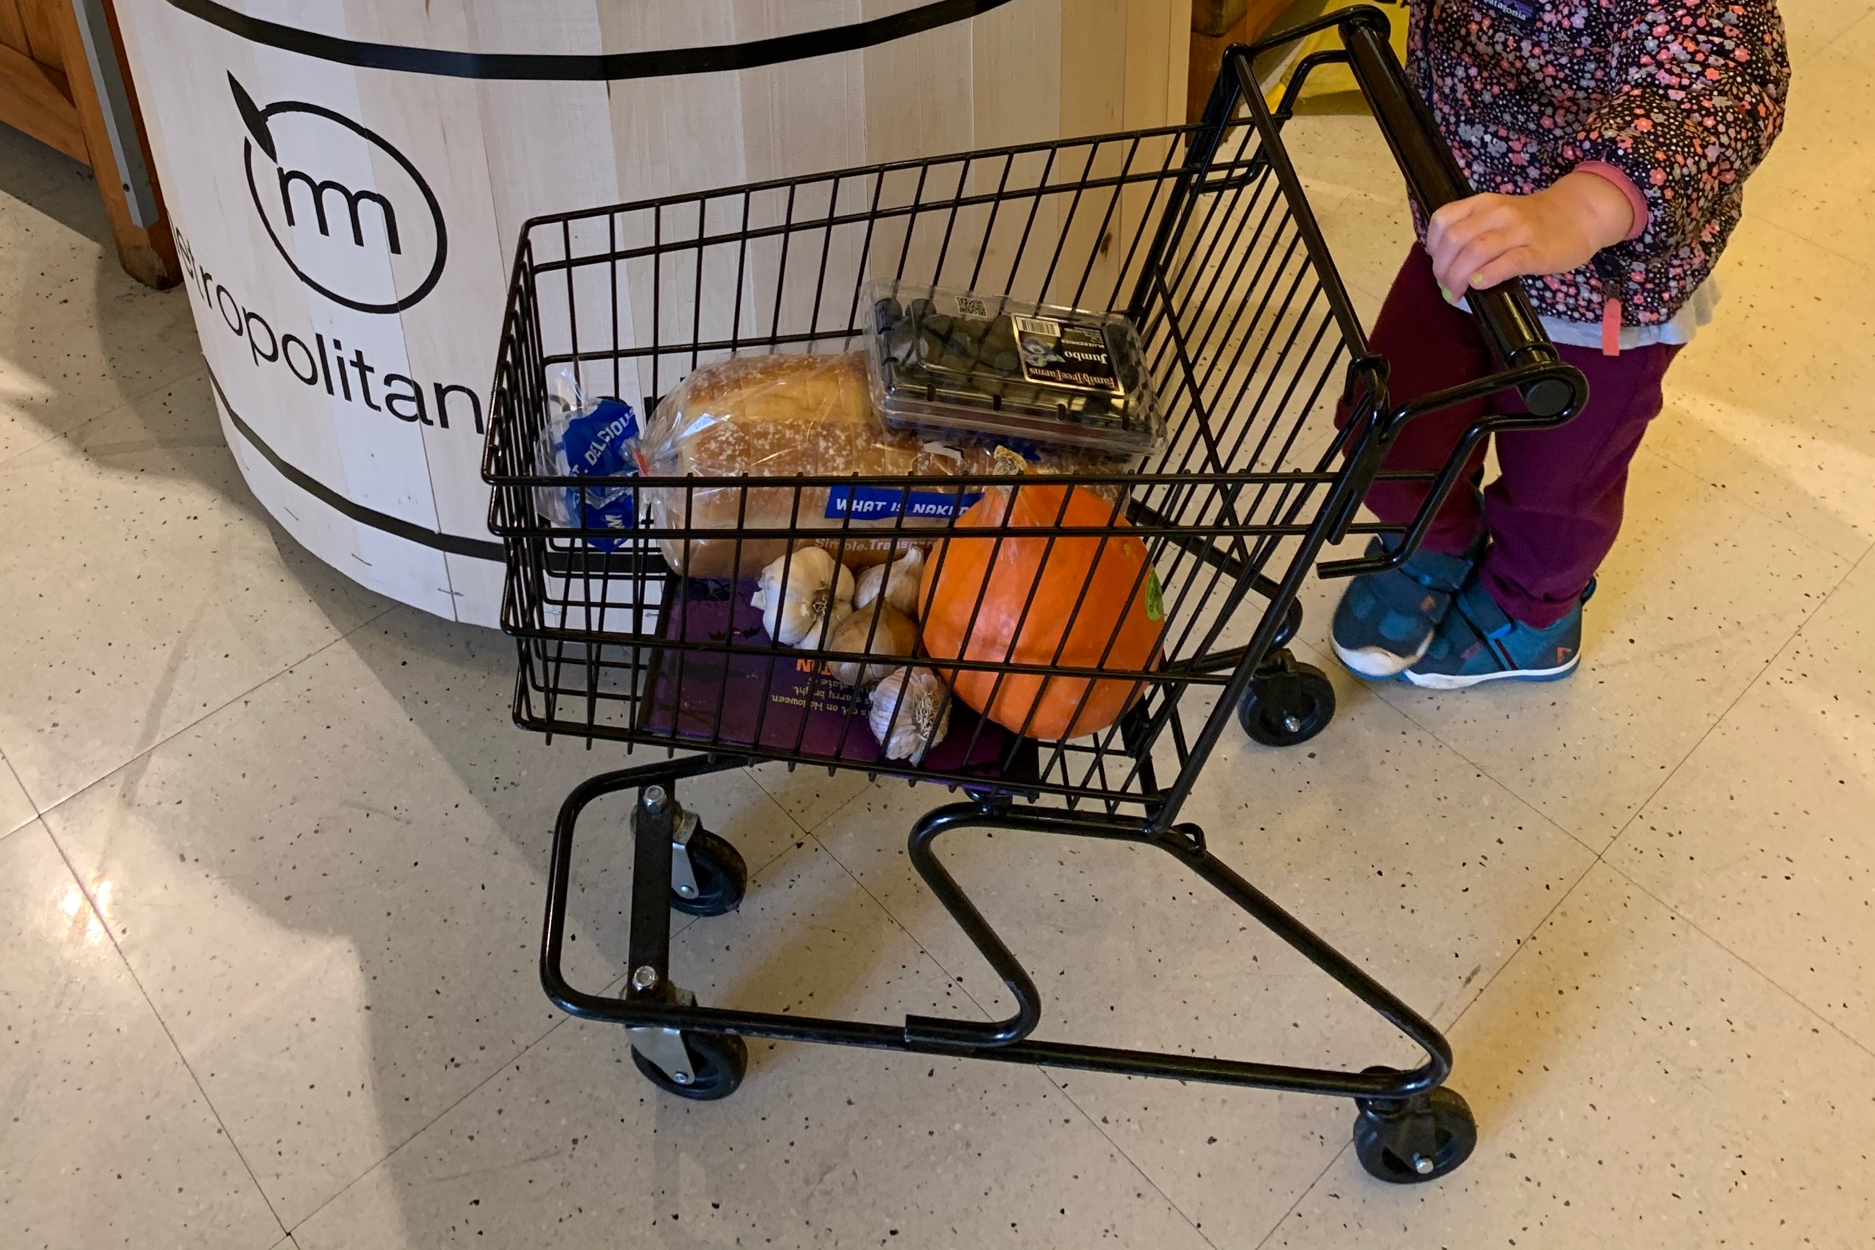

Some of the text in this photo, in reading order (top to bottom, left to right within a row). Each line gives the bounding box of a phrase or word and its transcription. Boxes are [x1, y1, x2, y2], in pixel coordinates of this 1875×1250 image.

[1064, 350, 1108, 365] Jumbo
[836, 498, 887, 512] WHAT
[829, 690, 861, 703] sarry
[826, 704, 838, 712] on
